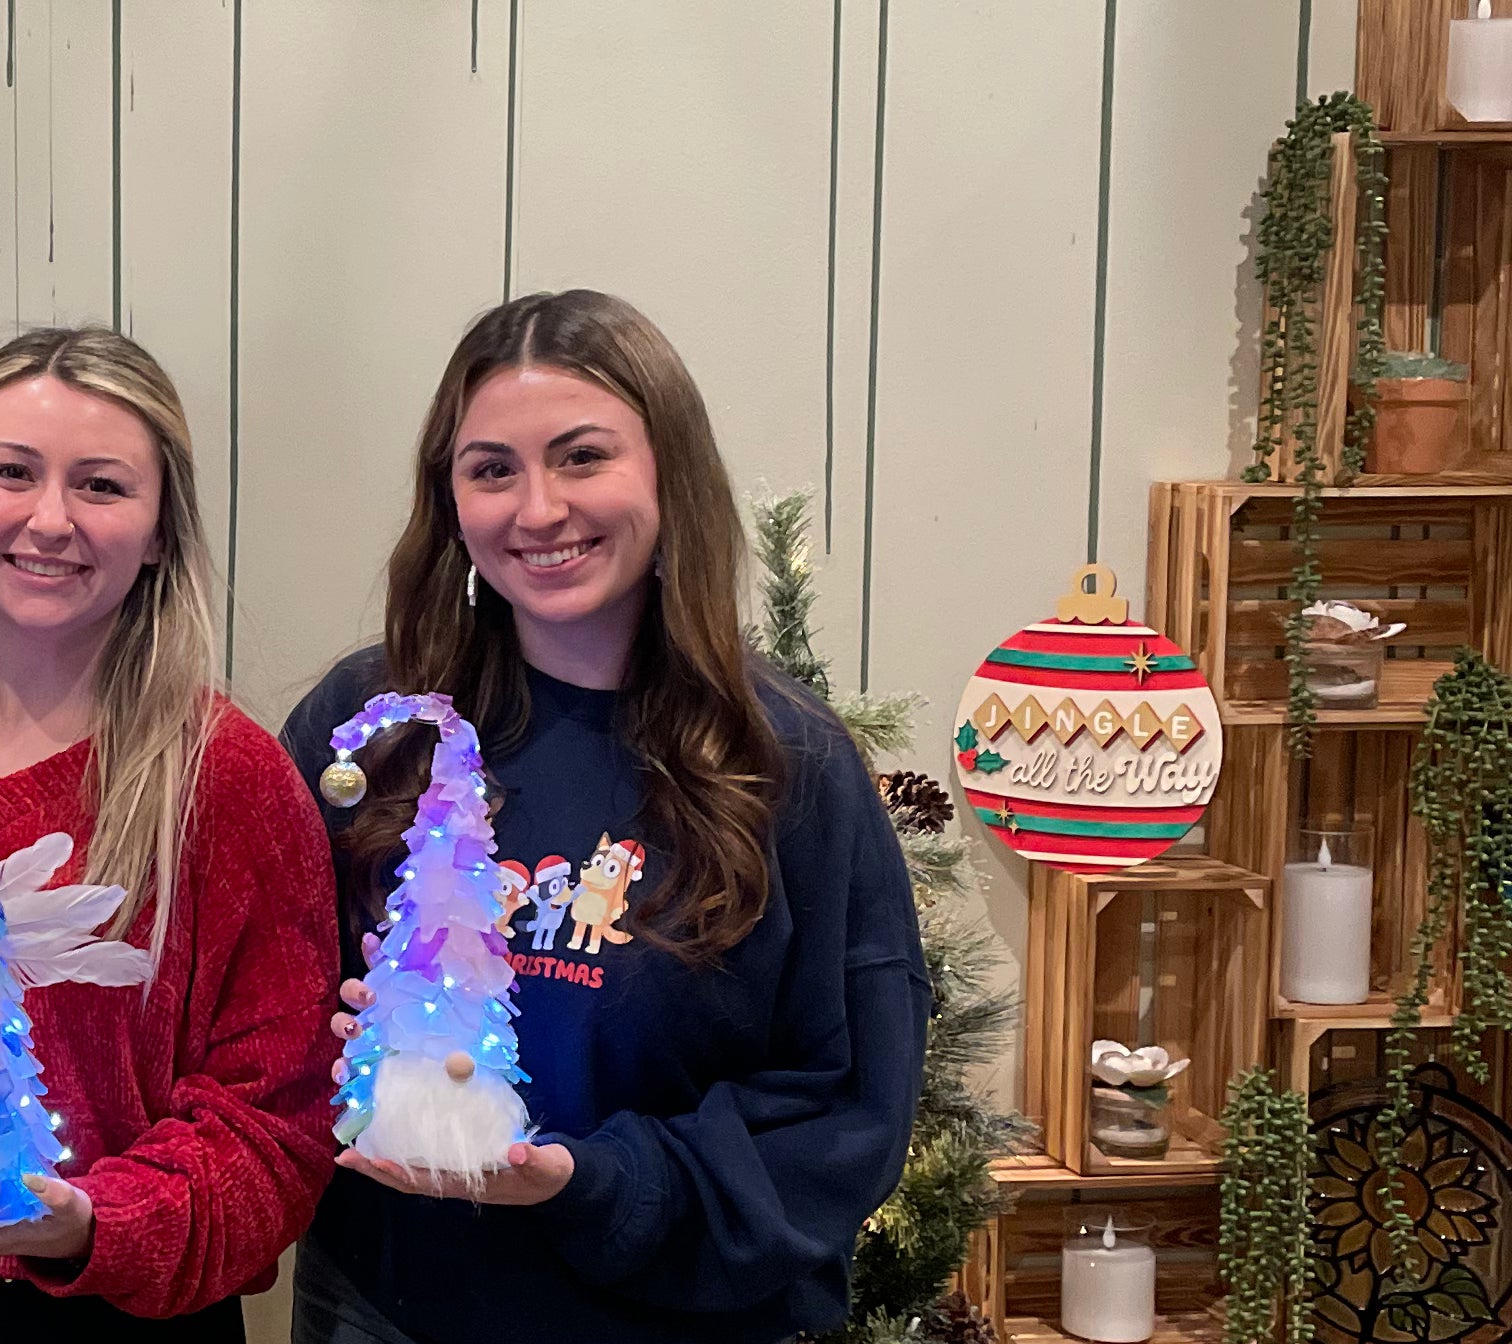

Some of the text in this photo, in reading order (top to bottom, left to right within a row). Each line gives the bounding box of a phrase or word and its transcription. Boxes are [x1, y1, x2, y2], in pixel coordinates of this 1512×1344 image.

[984, 704, 1191, 740] JINGLE
[1010, 750, 1217, 804] all the Way
